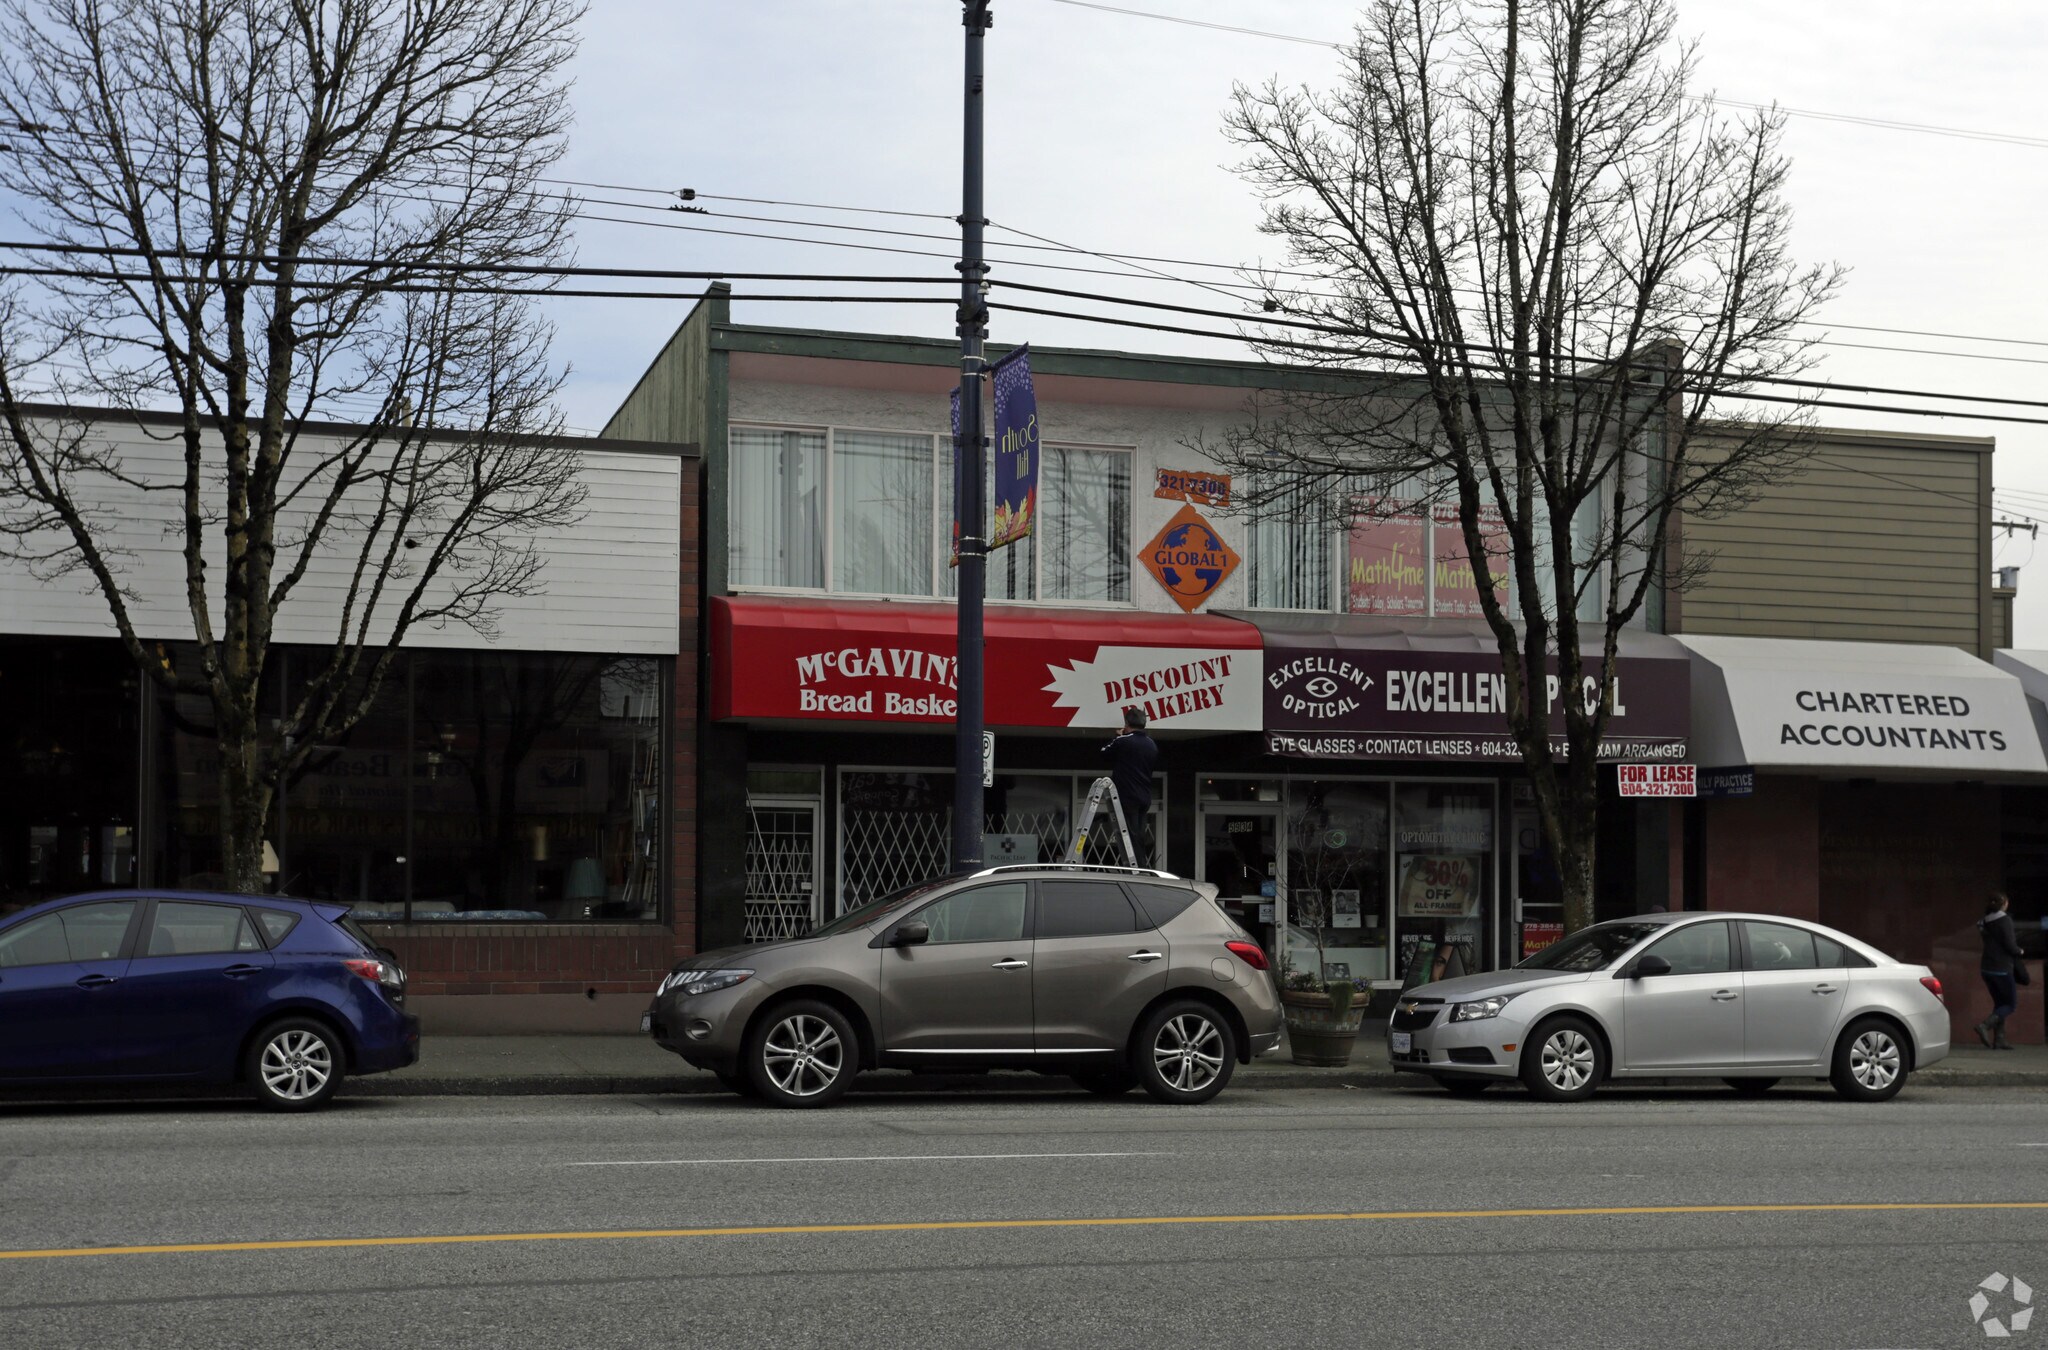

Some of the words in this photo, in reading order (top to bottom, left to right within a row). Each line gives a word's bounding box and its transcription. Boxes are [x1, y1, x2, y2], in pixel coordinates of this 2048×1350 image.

[1154, 550, 1218, 566] GLOBAL
[1221, 554, 1227, 567] 1
[1352, 542, 1424, 592] Math4me
[1435, 562, 1509, 590] Mathme
[1104, 655, 1232, 703] DISCOUNT
[1268, 657, 1375, 692] EXCELLENT
[800, 689, 873, 713] Bread
[885, 692, 958, 717] Baske
[1386, 670, 1506, 714] EXCELLEN
[1795, 691, 1970, 717] CHARTERED
[1282, 694, 1360, 718] OPTICAL
[1271, 737, 1296, 752] EYE
[1298, 738, 1356, 753] GLASSES
[1366, 739, 1422, 754] CONTACT
[1426, 740, 1472, 755] LENSES
[1596, 743, 1621, 757] XAM
[1622, 743, 1686, 758] ARRANGED
[1780, 724, 2008, 752] ACCOUNTANTS
[1620, 766, 1648, 782] FOR
[1653, 766, 1694, 782] LEASE
[1714, 773, 1753, 788] PRACTICE
[1621, 783, 1694, 795] 604-321-7300
[1425, 860, 1468, 889] 50%
[1425, 889, 1452, 900] OFF
[1431, 902, 1462, 910] FRAMES
